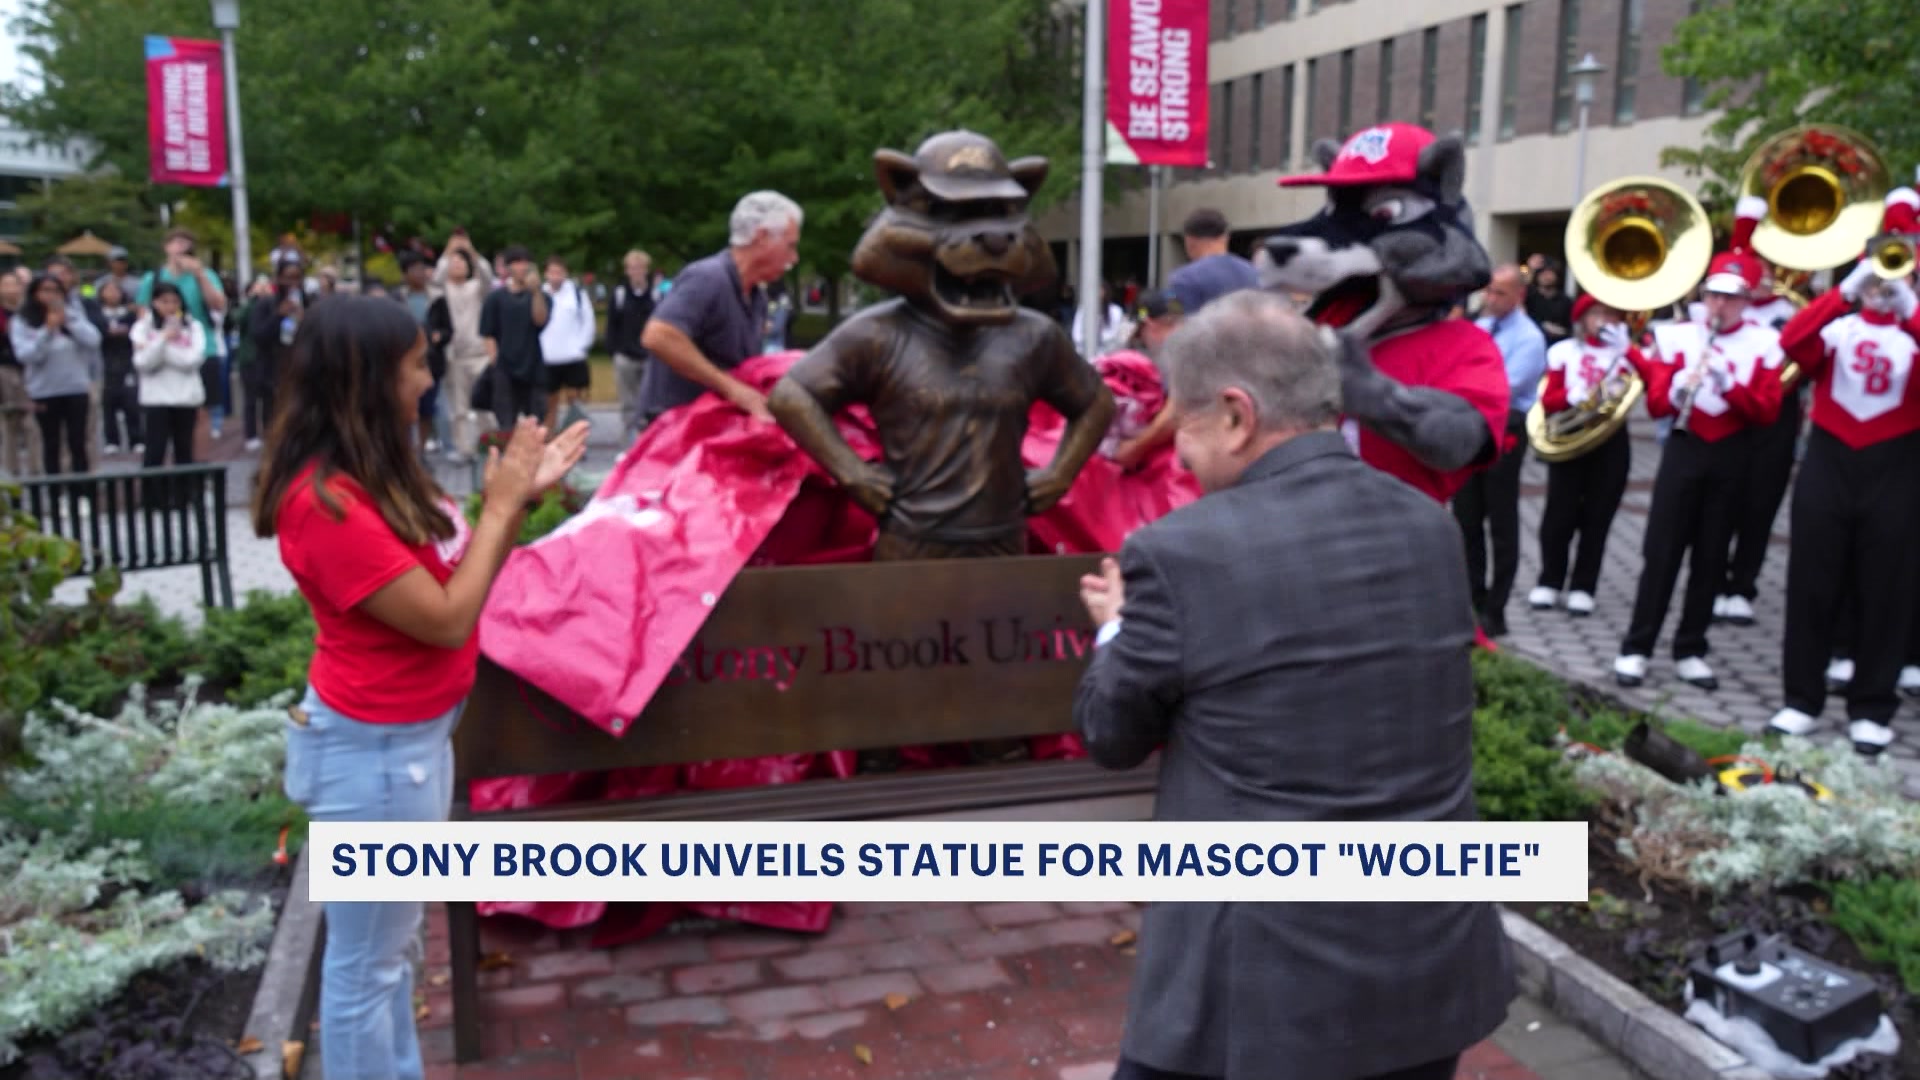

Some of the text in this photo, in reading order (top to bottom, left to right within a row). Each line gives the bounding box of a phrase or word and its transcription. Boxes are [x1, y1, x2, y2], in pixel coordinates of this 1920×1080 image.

[1160, 28, 1191, 141] STRONG
[1128, 102, 1160, 139] BE
[1851, 341, 1893, 396] SB
[819, 619, 969, 675] Brook
